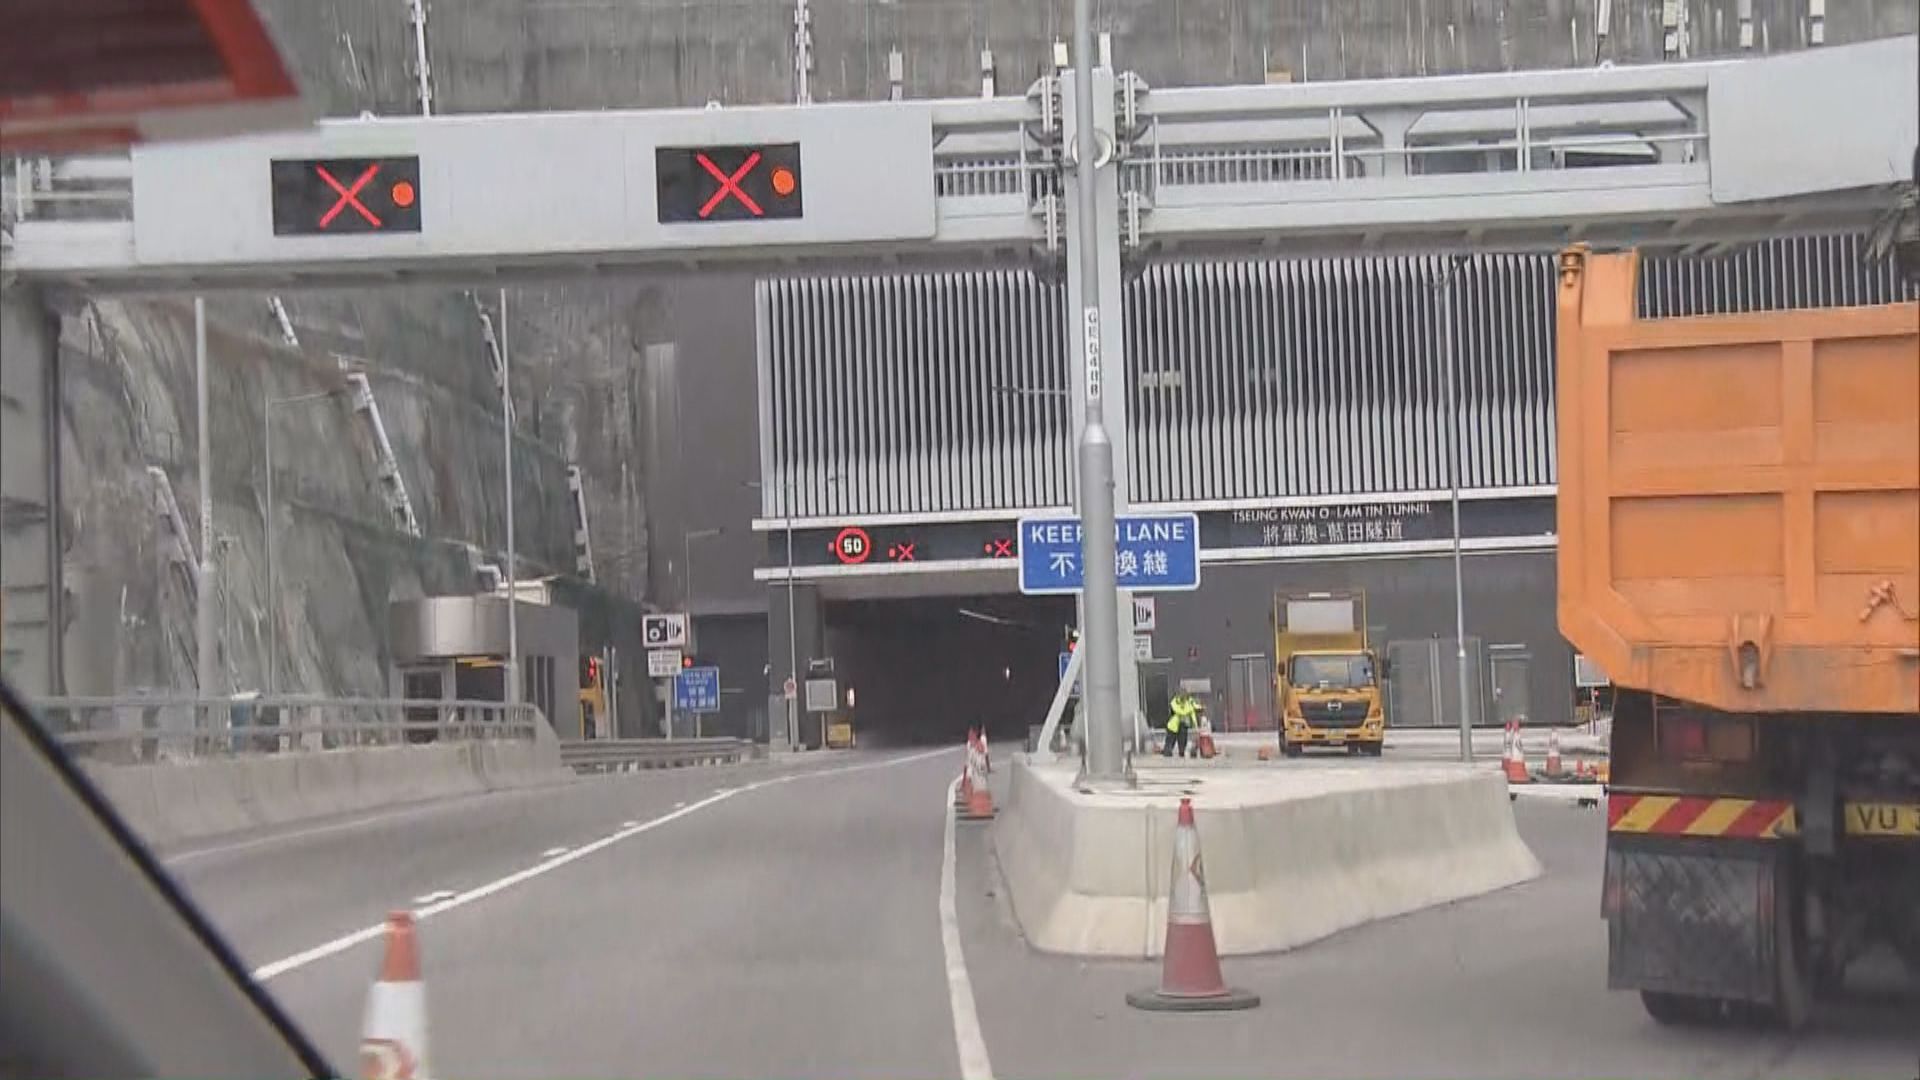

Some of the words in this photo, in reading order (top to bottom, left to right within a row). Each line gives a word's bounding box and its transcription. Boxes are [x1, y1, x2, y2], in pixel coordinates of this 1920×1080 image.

[1233, 509, 1278, 523] TSEUNG
[1281, 507, 1316, 521] KWAN
[1336, 504, 1363, 518] LAM
[1364, 503, 1383, 517] TIN
[1387, 501, 1431, 516] TUNNEL
[1127, 522, 1185, 541] LANE
[844, 538, 862, 553] 50
[1857, 805, 1898, 830] VU
